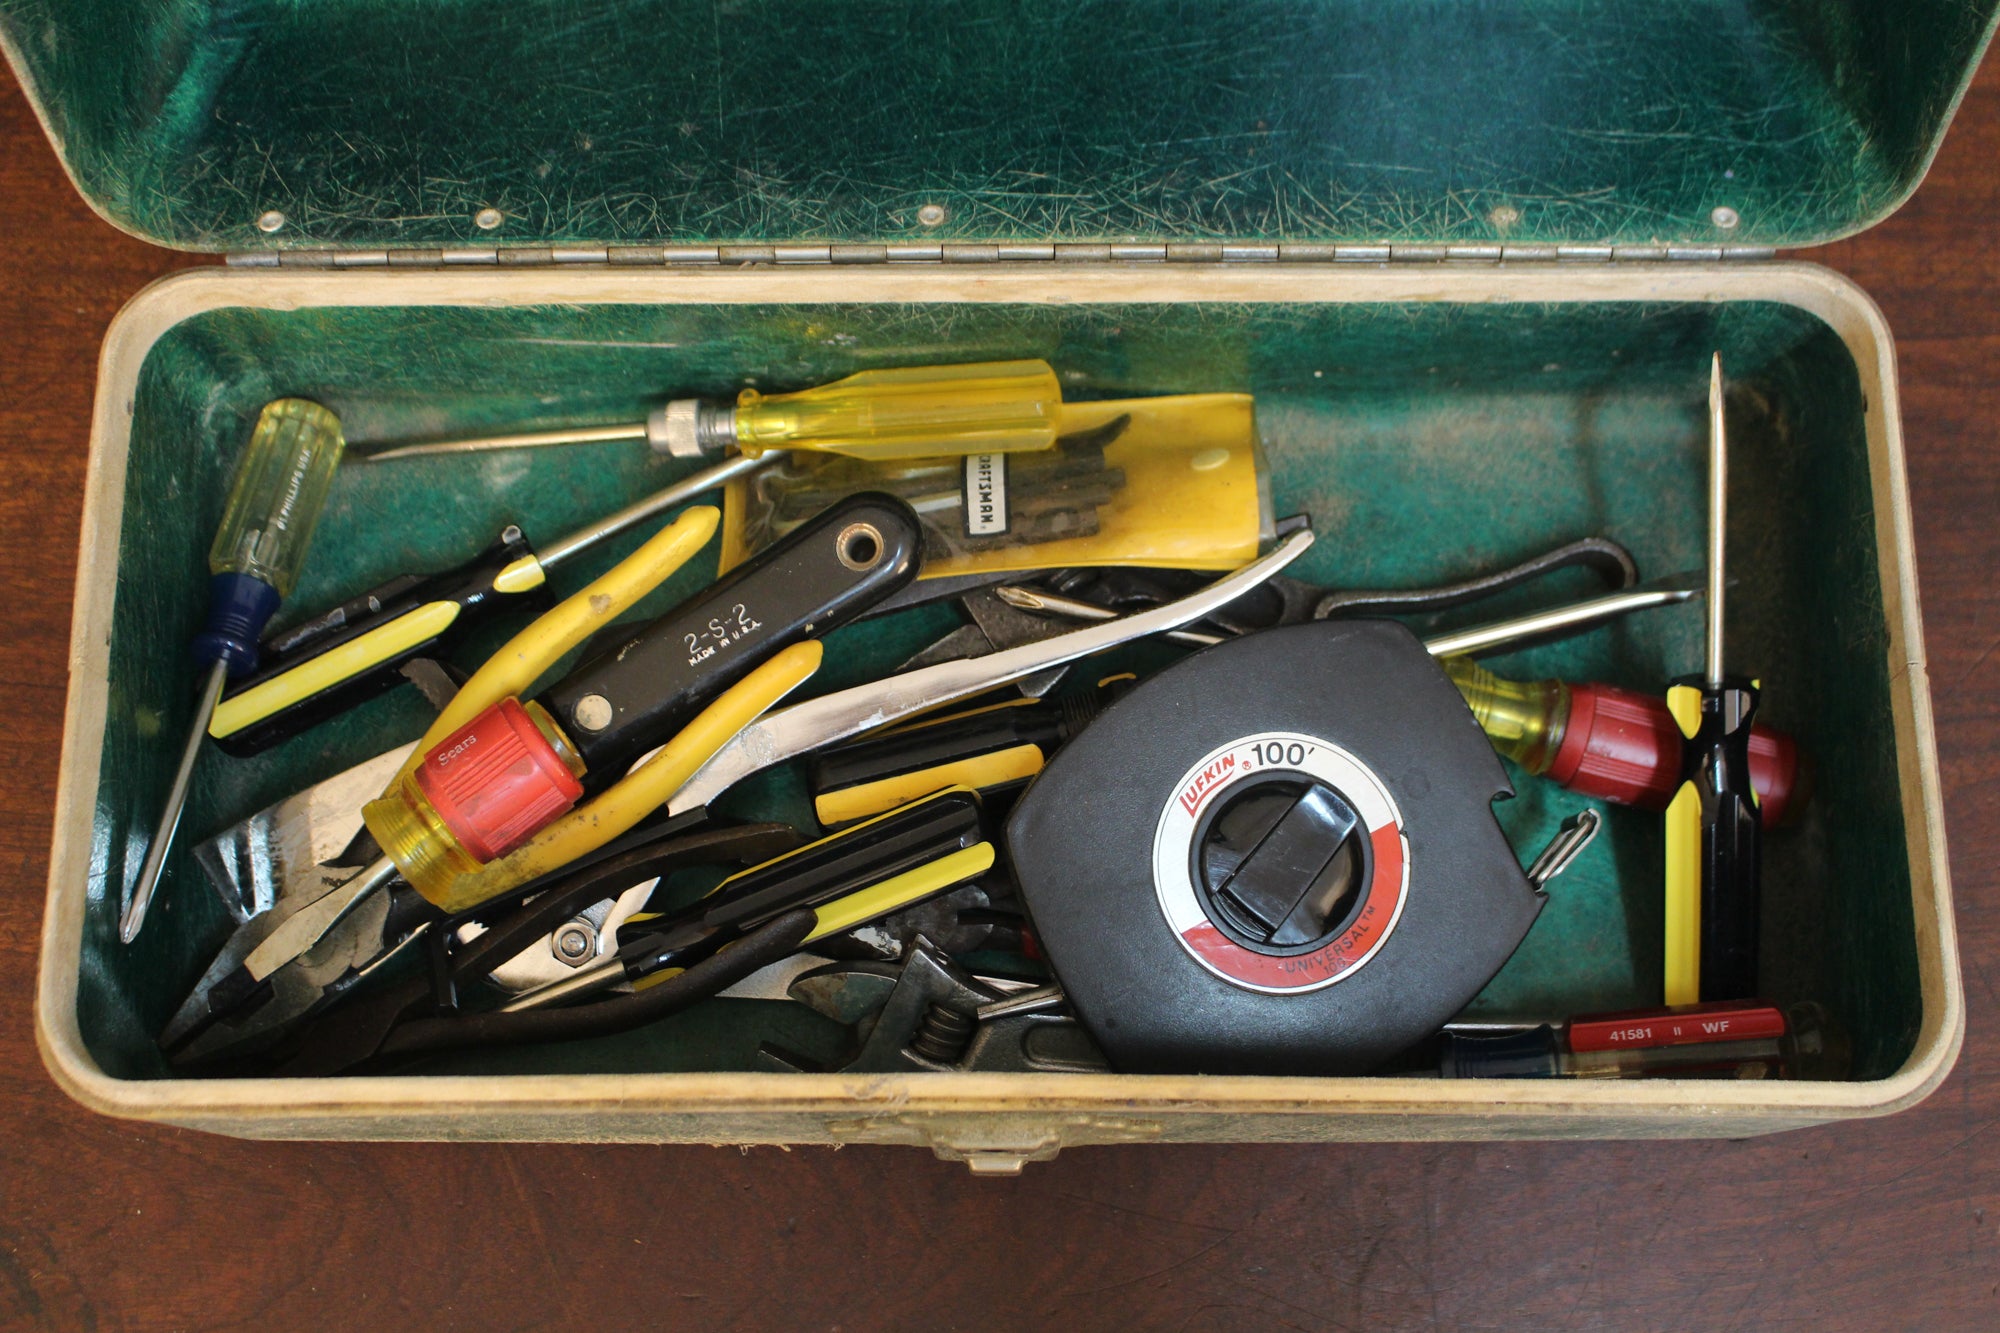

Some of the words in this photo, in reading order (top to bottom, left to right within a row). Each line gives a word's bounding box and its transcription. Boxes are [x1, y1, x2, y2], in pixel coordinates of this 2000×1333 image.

[280, 470, 304, 517] PHILLIPS
[296, 449, 312, 470] USA
[684, 603, 751, 655] 2-S-2
[688, 645, 716, 667] MADE
[719, 637, 731, 648] IN
[438, 735, 477, 767] Sears
[1179, 753, 1235, 819] LUFKIN
[1610, 1027, 1652, 1041] 41581
[1702, 1020, 1730, 1034] WF
